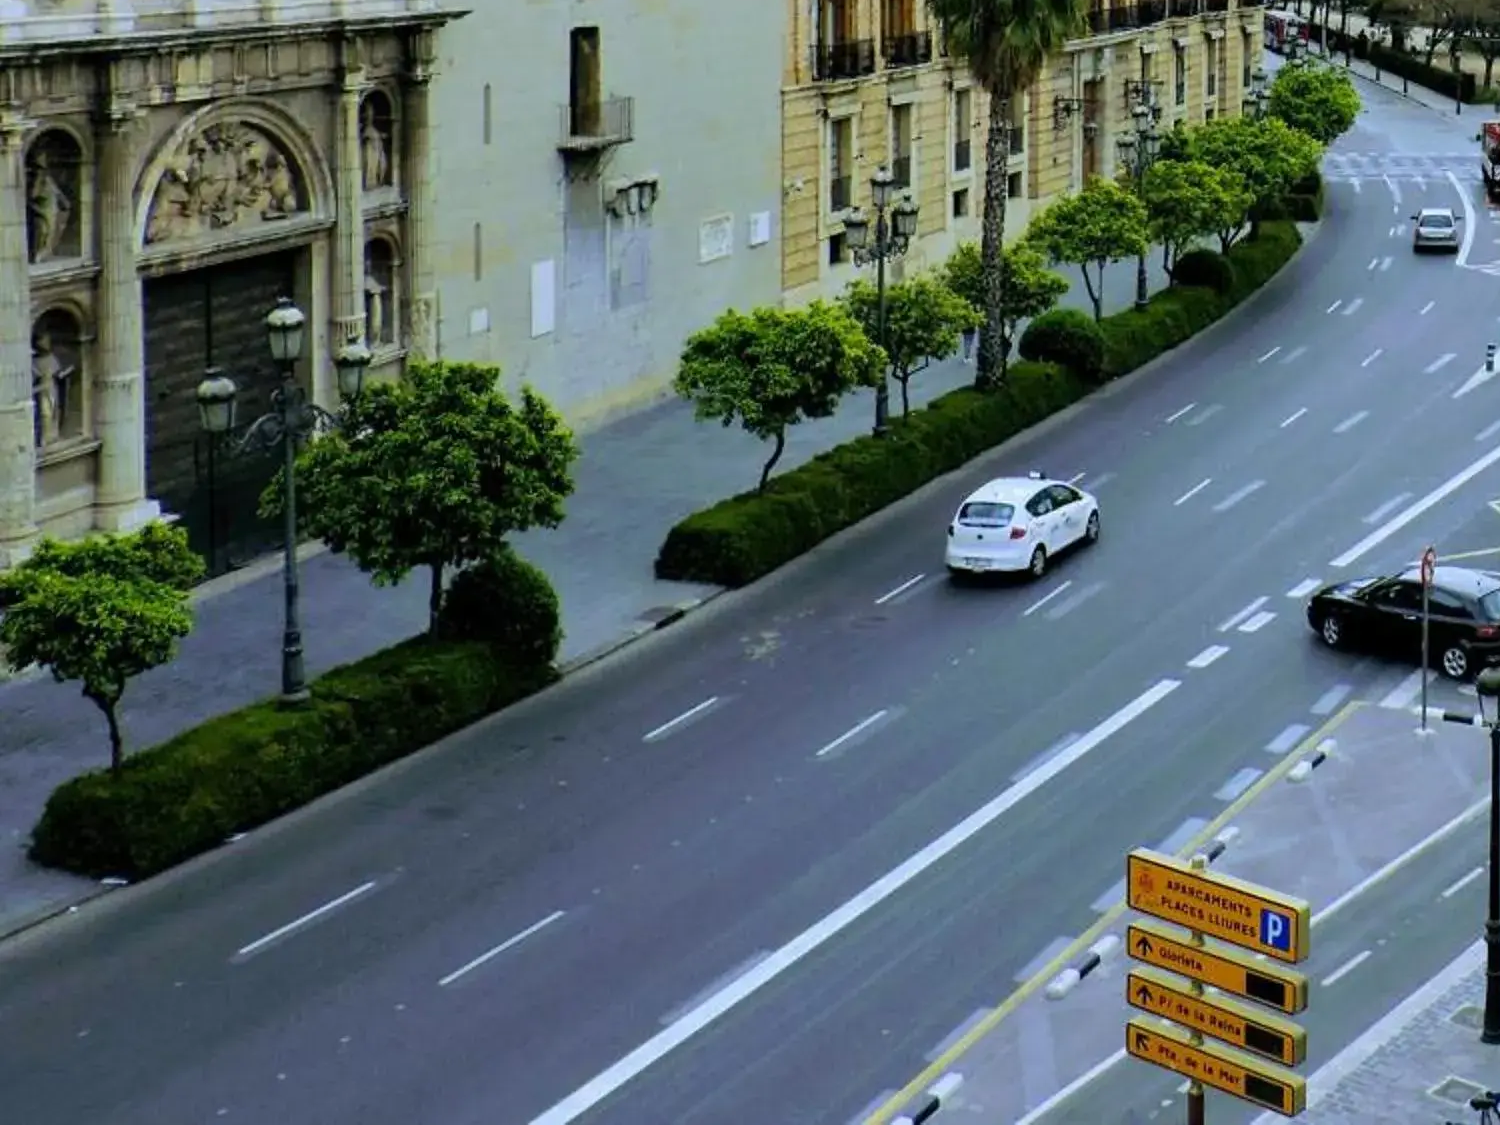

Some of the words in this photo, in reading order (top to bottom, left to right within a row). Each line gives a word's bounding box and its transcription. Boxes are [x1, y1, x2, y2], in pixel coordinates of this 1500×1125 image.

[1161, 896, 1205, 921] PLACES
[1208, 913, 1256, 938] LLIURES
[1167, 880, 1253, 917] APARCAMENTS
[1159, 946, 1204, 972] Glorieta
